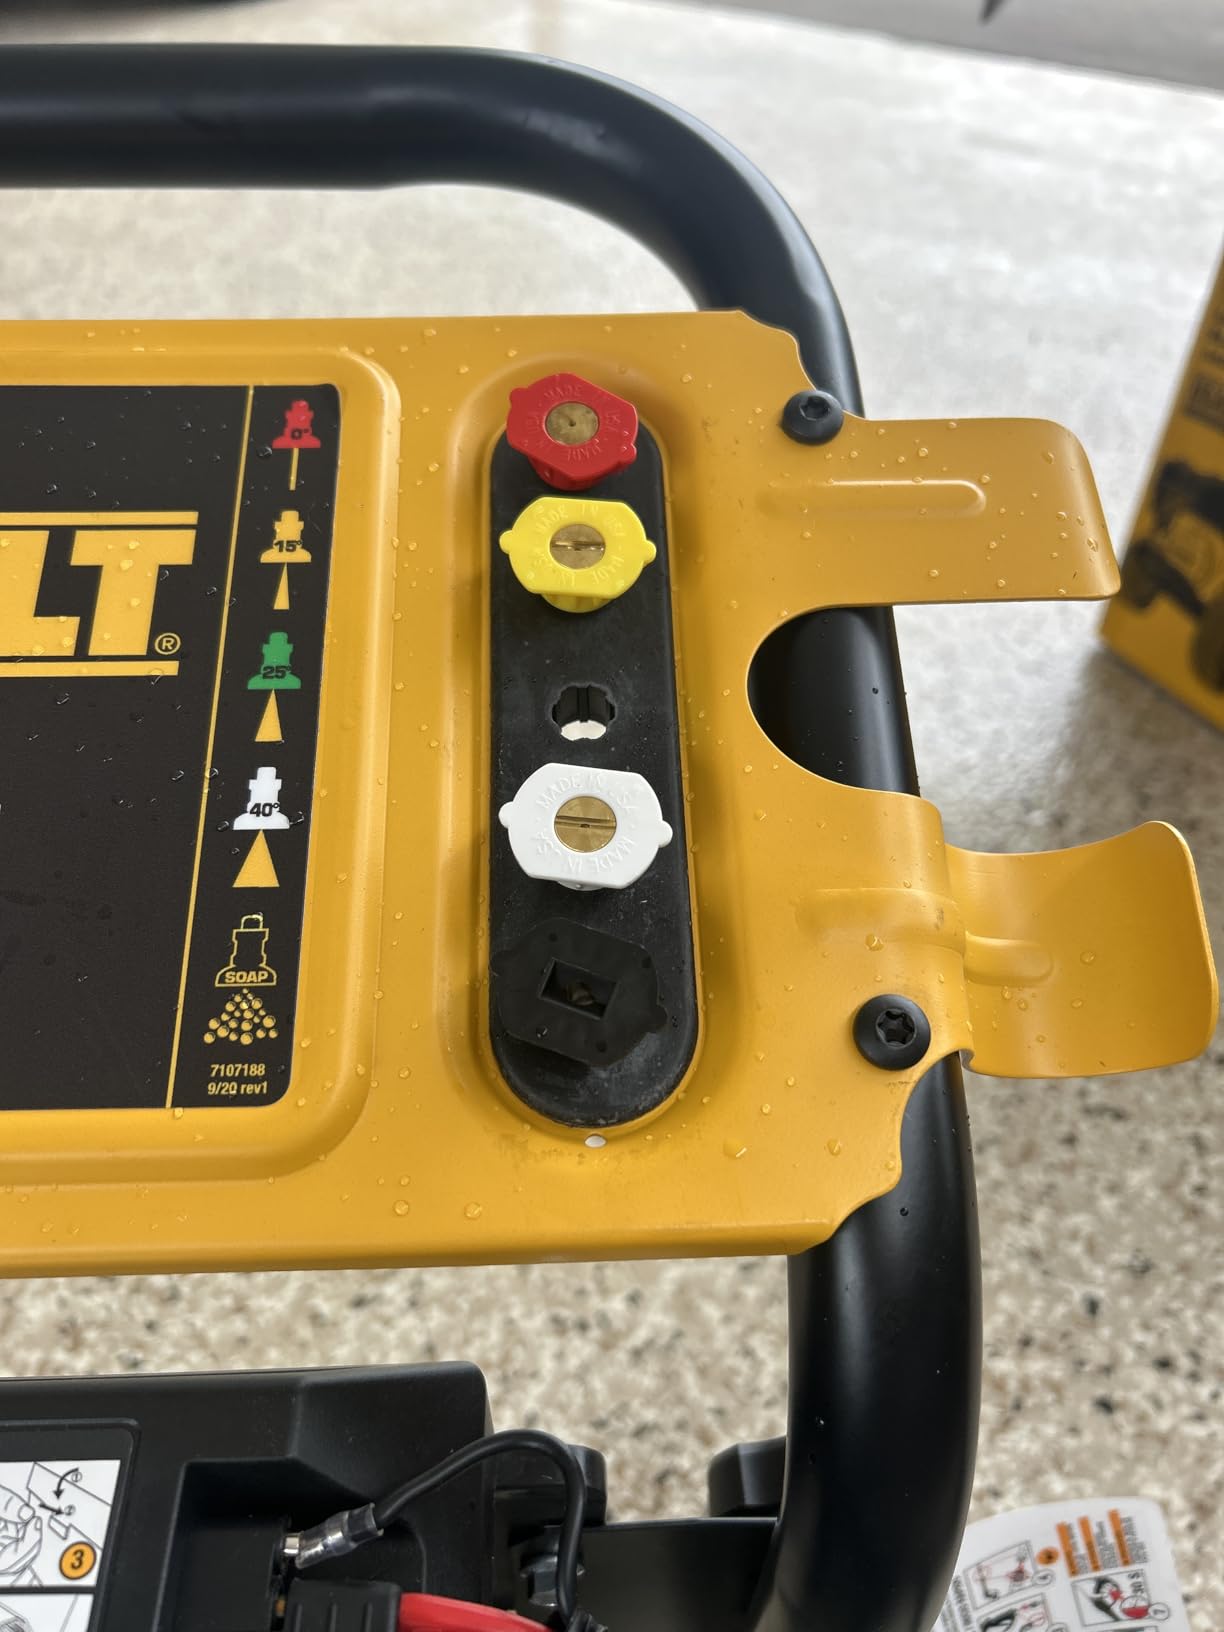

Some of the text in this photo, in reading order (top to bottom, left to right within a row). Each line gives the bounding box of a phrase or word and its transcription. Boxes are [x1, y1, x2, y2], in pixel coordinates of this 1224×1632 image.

[274, 540, 303, 553] 15°
[262, 664, 291, 680] 25°
[249, 802, 281, 818] 40°
[225, 970, 269, 983] SOAP
[210, 1063, 266, 1078] 7107188
[207, 1080, 268, 1096] 9/20 rev1
[71, 1549, 84, 1570] 3
